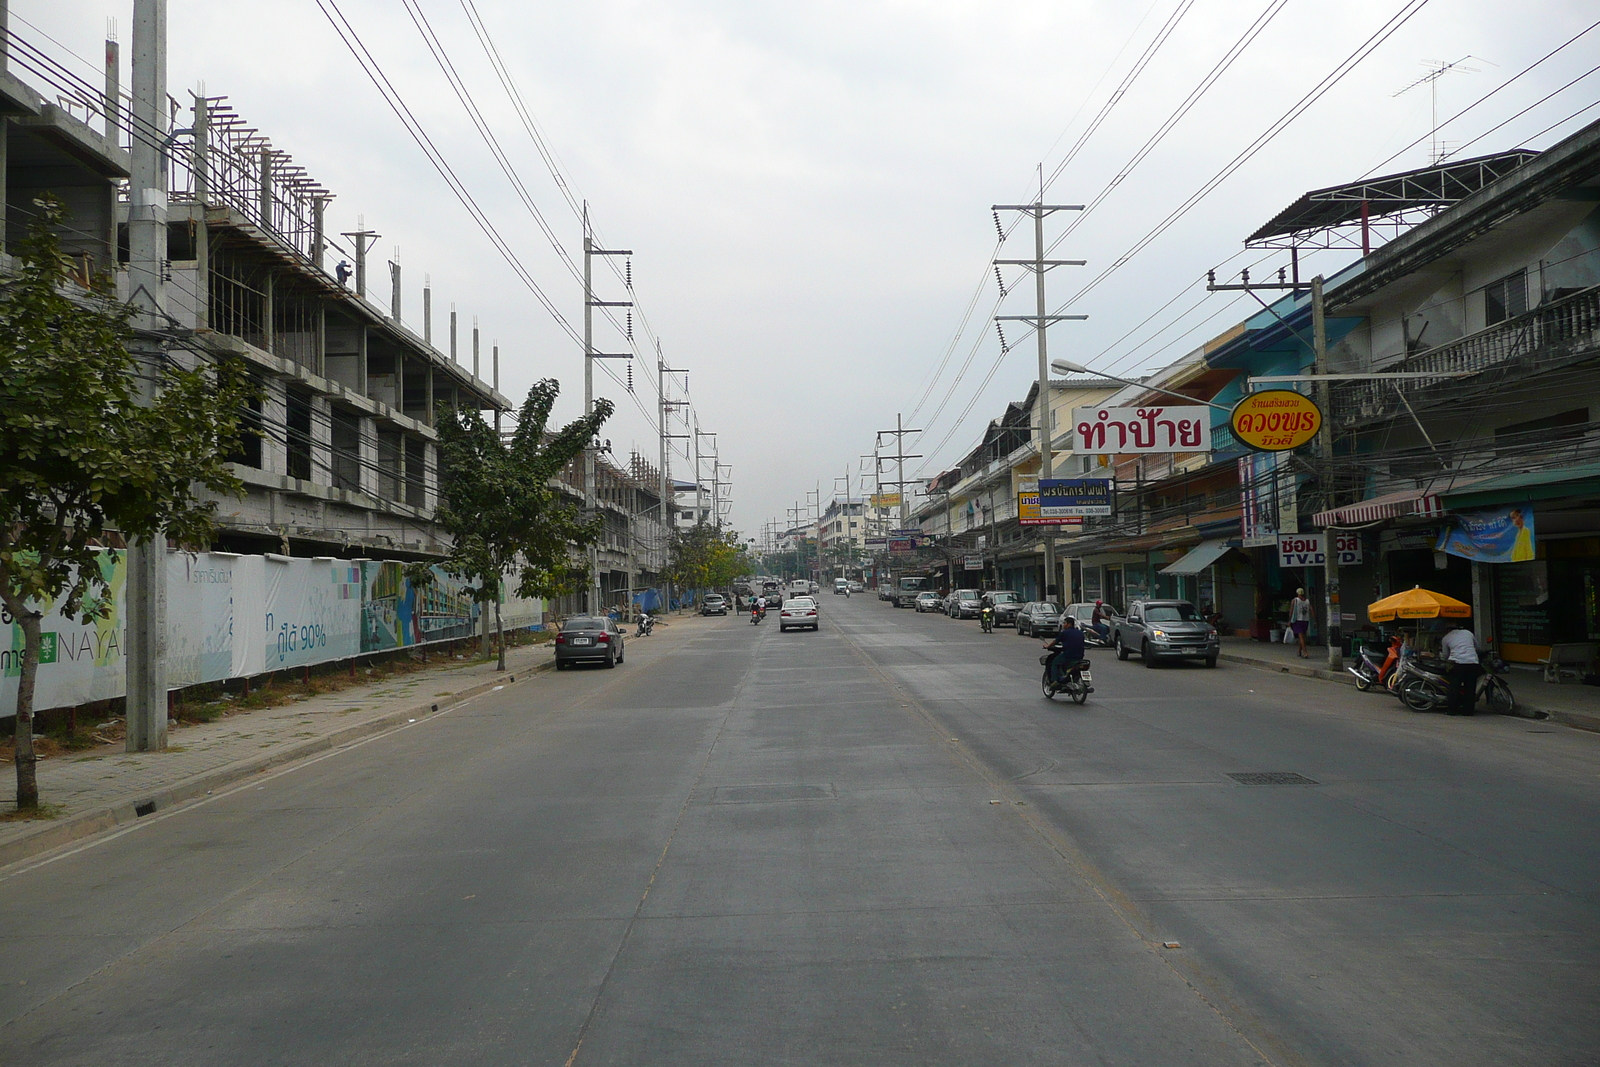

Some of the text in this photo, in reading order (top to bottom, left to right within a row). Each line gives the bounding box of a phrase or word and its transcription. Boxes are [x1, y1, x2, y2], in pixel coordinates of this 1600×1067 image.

[1251, 397, 1300, 409] ร้านเสริมสวย
[1077, 408, 1202, 449] ทำป้าย
[1237, 411, 1315, 433] ดวงพร
[1281, 536, 1318, 553] ซ่อม
[57, 628, 127, 663] NAYA
[277, 622, 297, 661] กู้ได้
[301, 624, 327, 651] 90%
